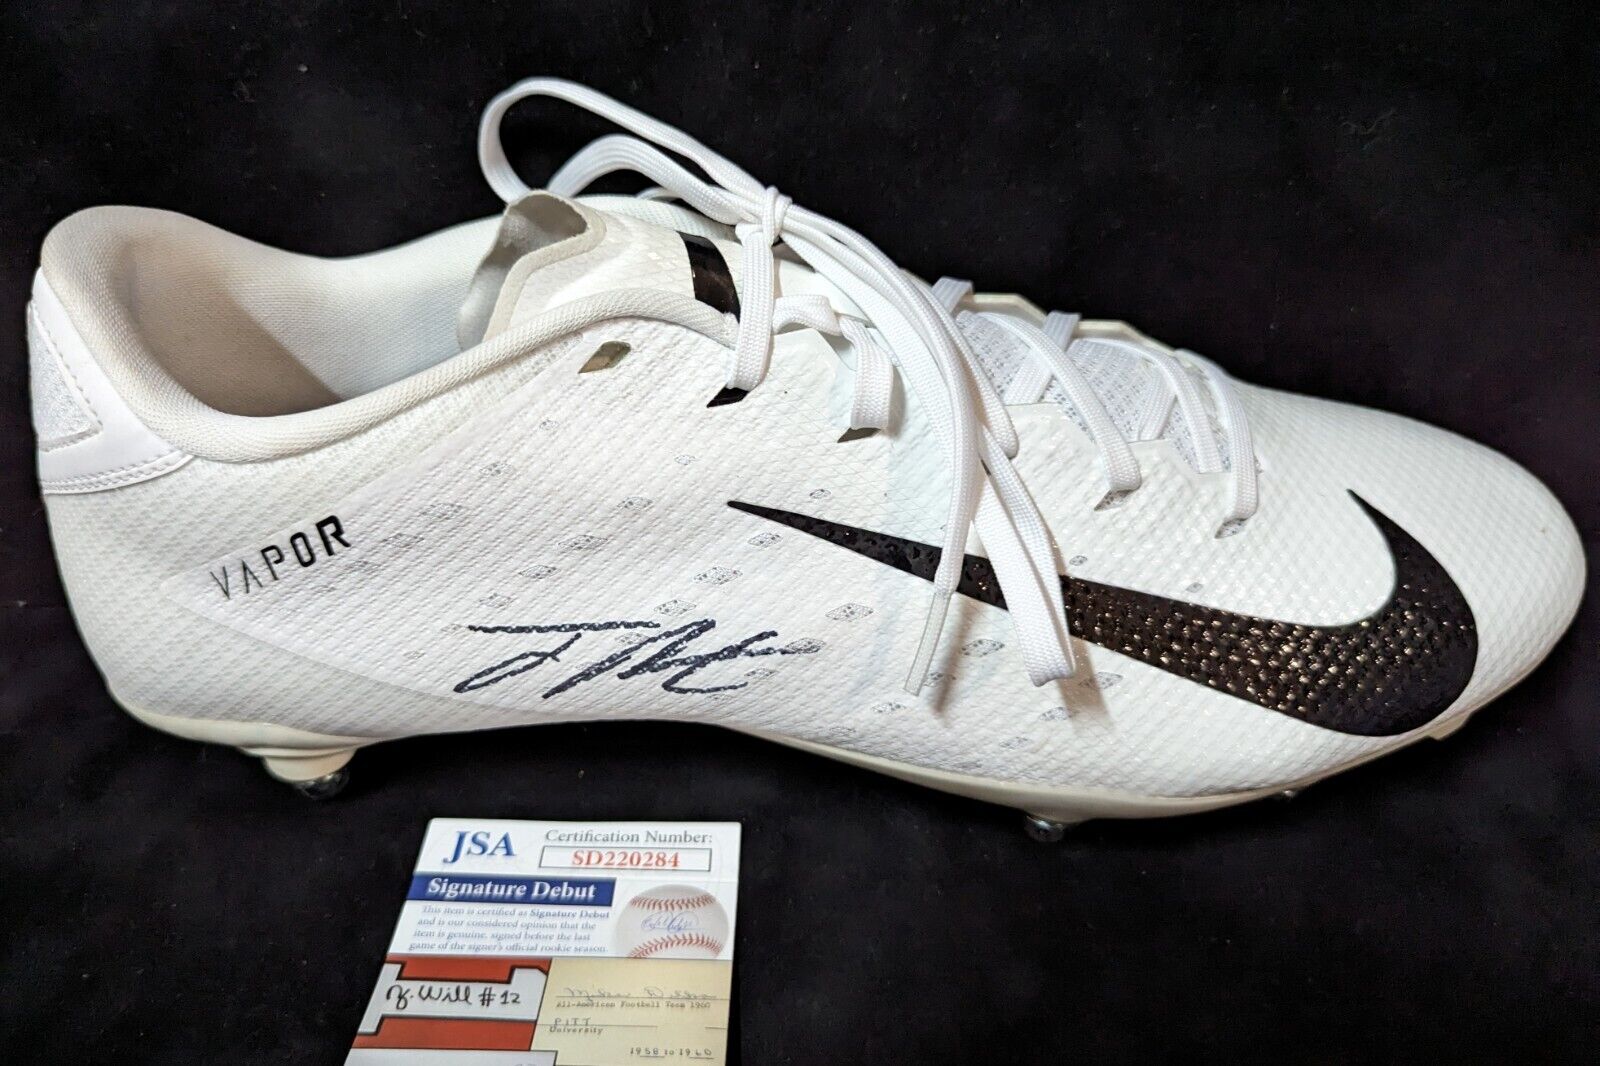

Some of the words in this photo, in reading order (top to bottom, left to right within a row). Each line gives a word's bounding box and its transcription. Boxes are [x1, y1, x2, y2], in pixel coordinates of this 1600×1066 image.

[208, 514, 352, 600] VAPOR
[545, 829, 640, 843] Certification
[644, 830, 713, 844] Number:
[442, 830, 517, 864] JSA
[572, 850, 681, 868] SD220284
[427, 877, 527, 898] Signature
[531, 881, 597, 898] Debut
[422, 905, 441, 914] This
[444, 906, 465, 915] item
[467, 906, 475, 915] is
[478, 906, 516, 916] certified
[518, 909, 528, 917] as
[530, 908, 577, 919] Signature
[579, 909, 610, 919] Debut
[418, 917, 436, 925] and
[438, 918, 445, 926] is
[466, 919, 518, 928] considered
[520, 920, 558, 930] opinion
[560, 921, 579, 929] that
[581, 922, 597, 930] the
[413, 929, 435, 937] item
[437, 930, 446, 938] is
[490, 931, 522, 941] signed
[524, 931, 555, 940] before
[557, 932, 571, 940] the
[574, 932, 591, 941] last
[408, 943, 437, 951] game
[439, 942, 450, 950] of
[450, 942, 466, 950] the
[505, 943, 538, 952] official
[540, 944, 573, 952] rookie
[417, 985, 472, 1005] Will
[620, 1000, 661, 1009] Football
[554, 1018, 592, 1026] PITT
[549, 1026, 604, 1035] University
